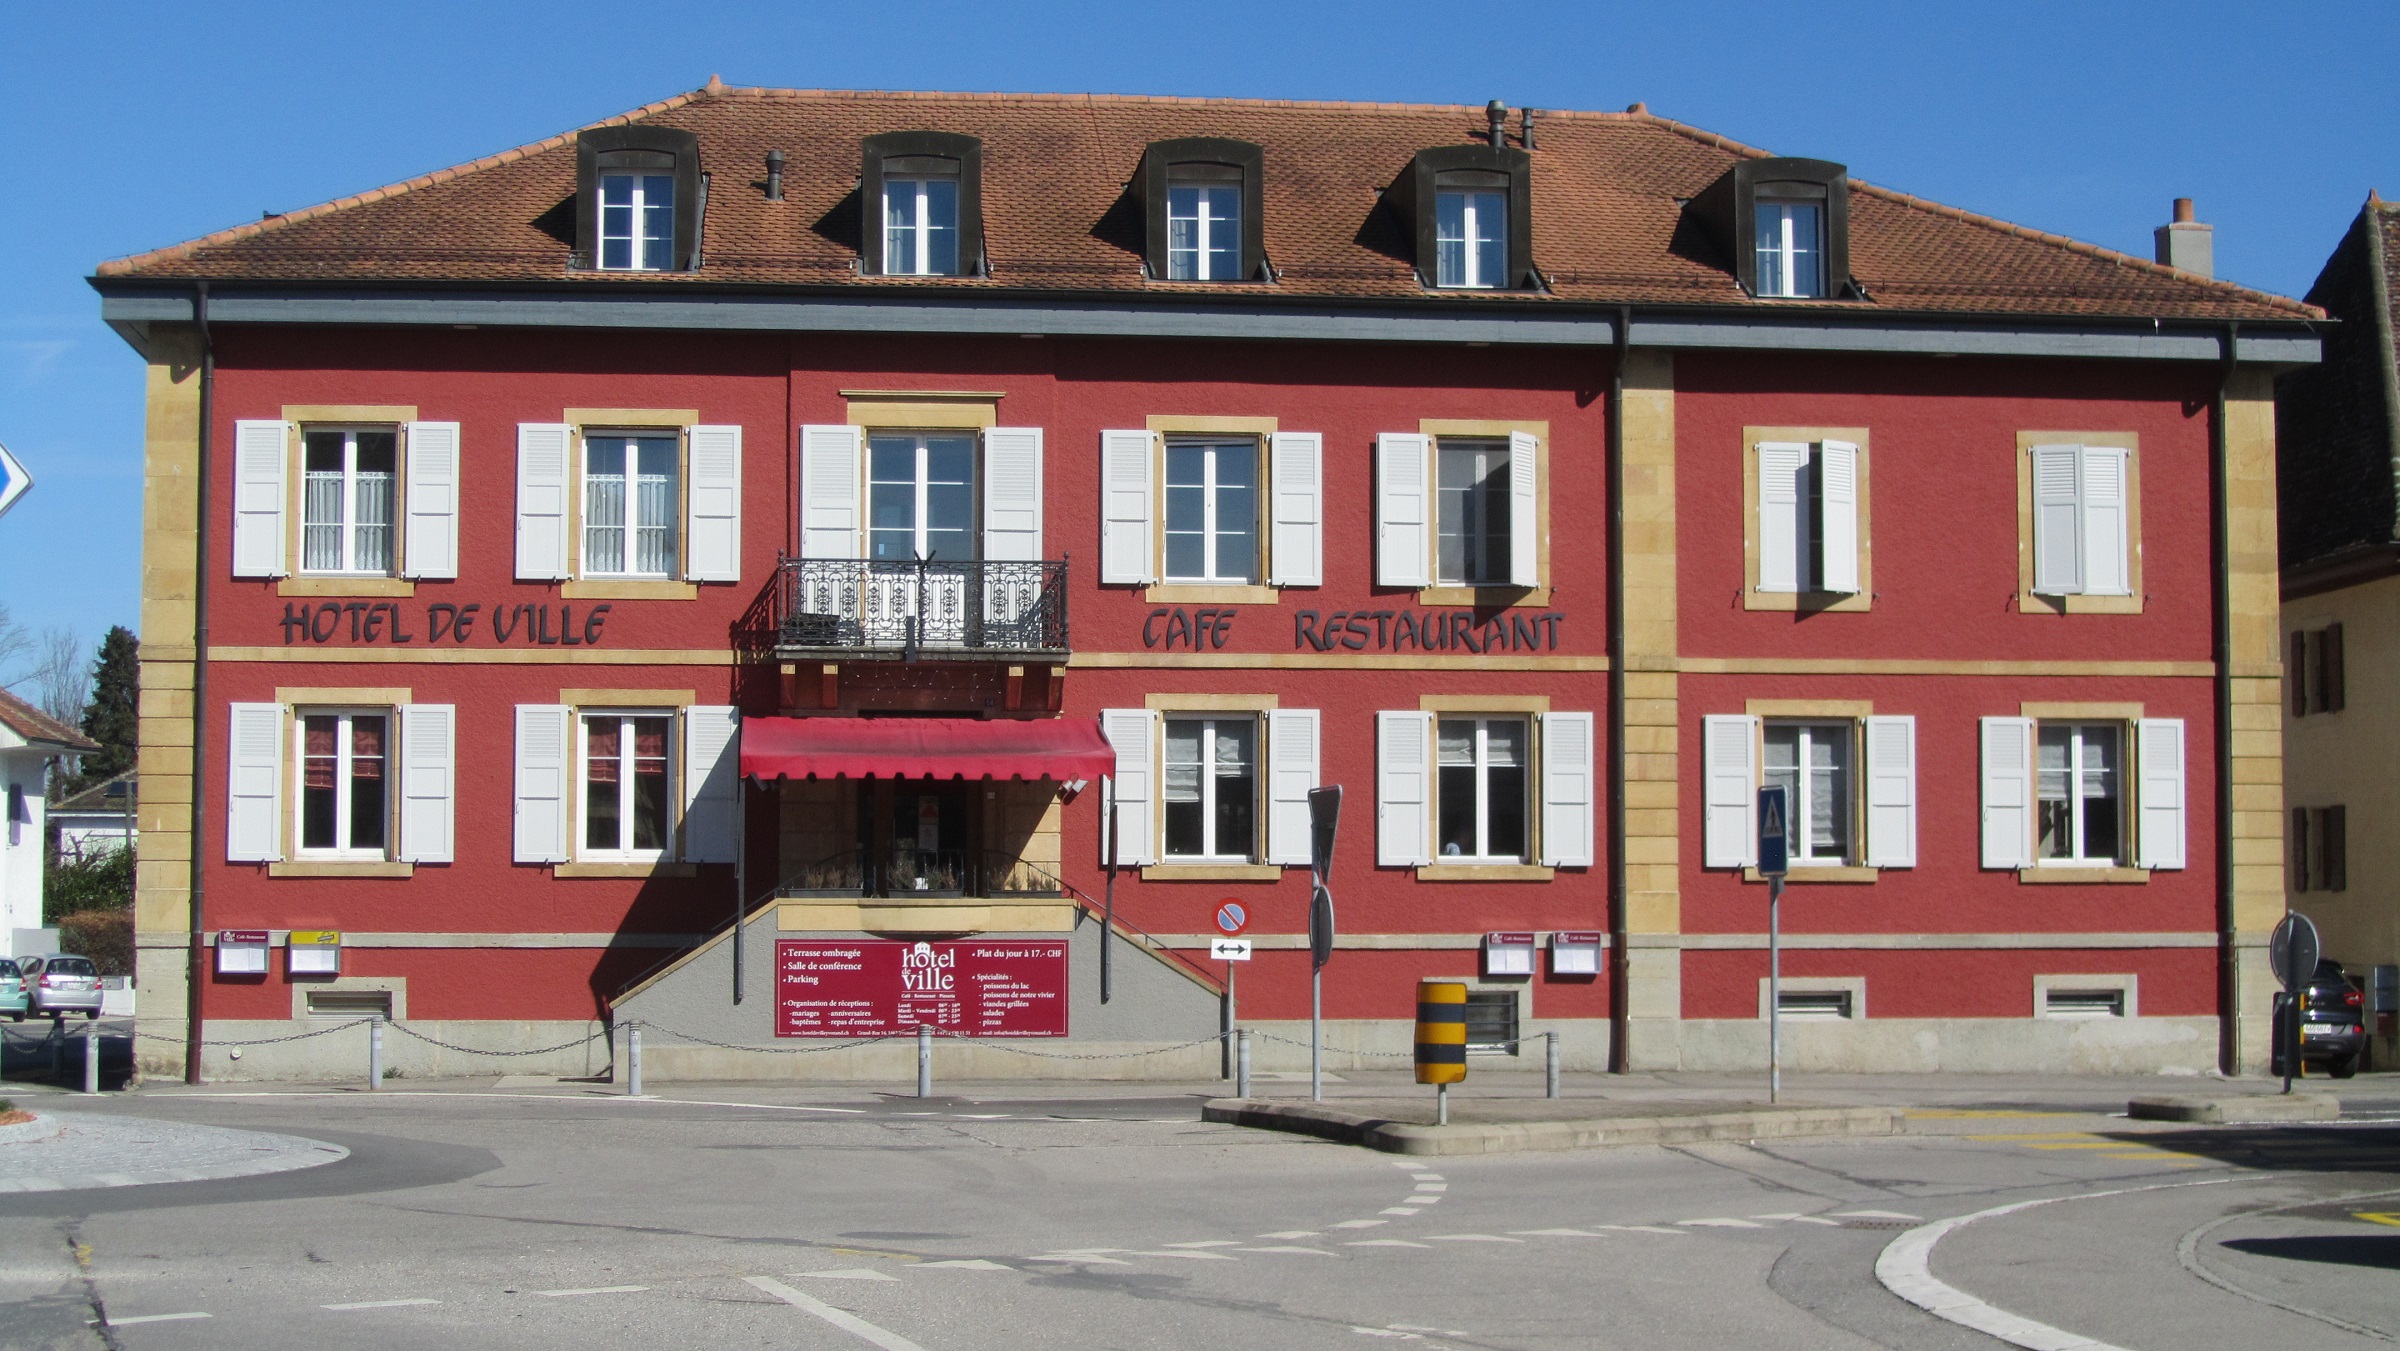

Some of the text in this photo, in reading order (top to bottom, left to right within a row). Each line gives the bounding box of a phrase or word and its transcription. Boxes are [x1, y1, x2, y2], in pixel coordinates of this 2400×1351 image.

[279, 602, 612, 645] HOTEL DE VILLE
[1143, 608, 1566, 654] CAFE RESTAURANT
[788, 948, 861, 959] Terrasse ombragée
[977, 949, 992, 958] Plat
[994, 949, 1004, 958] du
[1006, 949, 1022, 959] jour
[1024, 949, 1029, 958] à
[1047, 950, 1062, 958] CHF
[788, 962, 862, 970] Salle de conférence
[788, 975, 819, 985] Parking
[901, 967, 954, 990] ville
[788, 1000, 828, 1008] Organisation
[838, 1000, 870, 1008] réceptions
[1007, 1000, 1029, 1009] grillées
